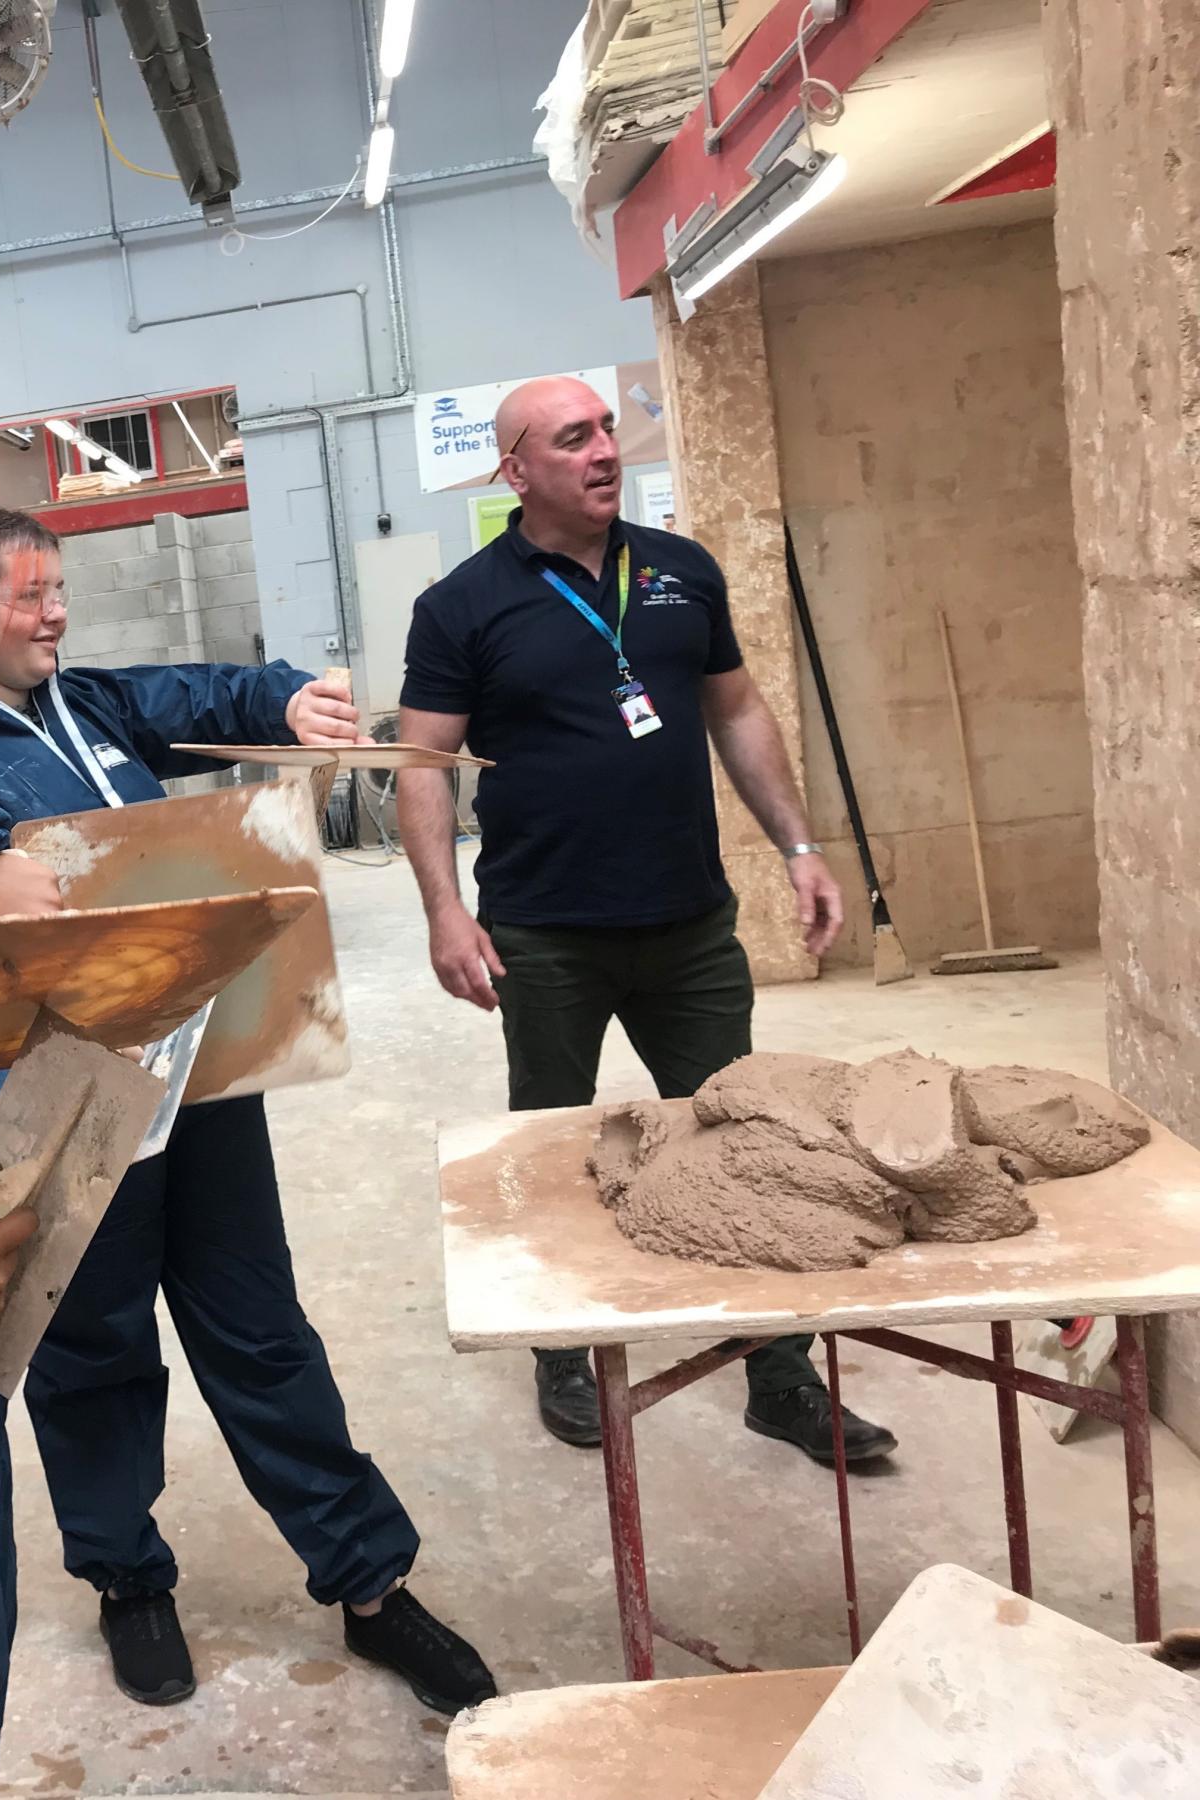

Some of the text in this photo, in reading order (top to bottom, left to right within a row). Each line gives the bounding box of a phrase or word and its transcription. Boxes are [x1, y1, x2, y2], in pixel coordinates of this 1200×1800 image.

[432, 419, 497, 440] Support
[434, 441, 450, 456] of
[455, 439, 481, 453] the
